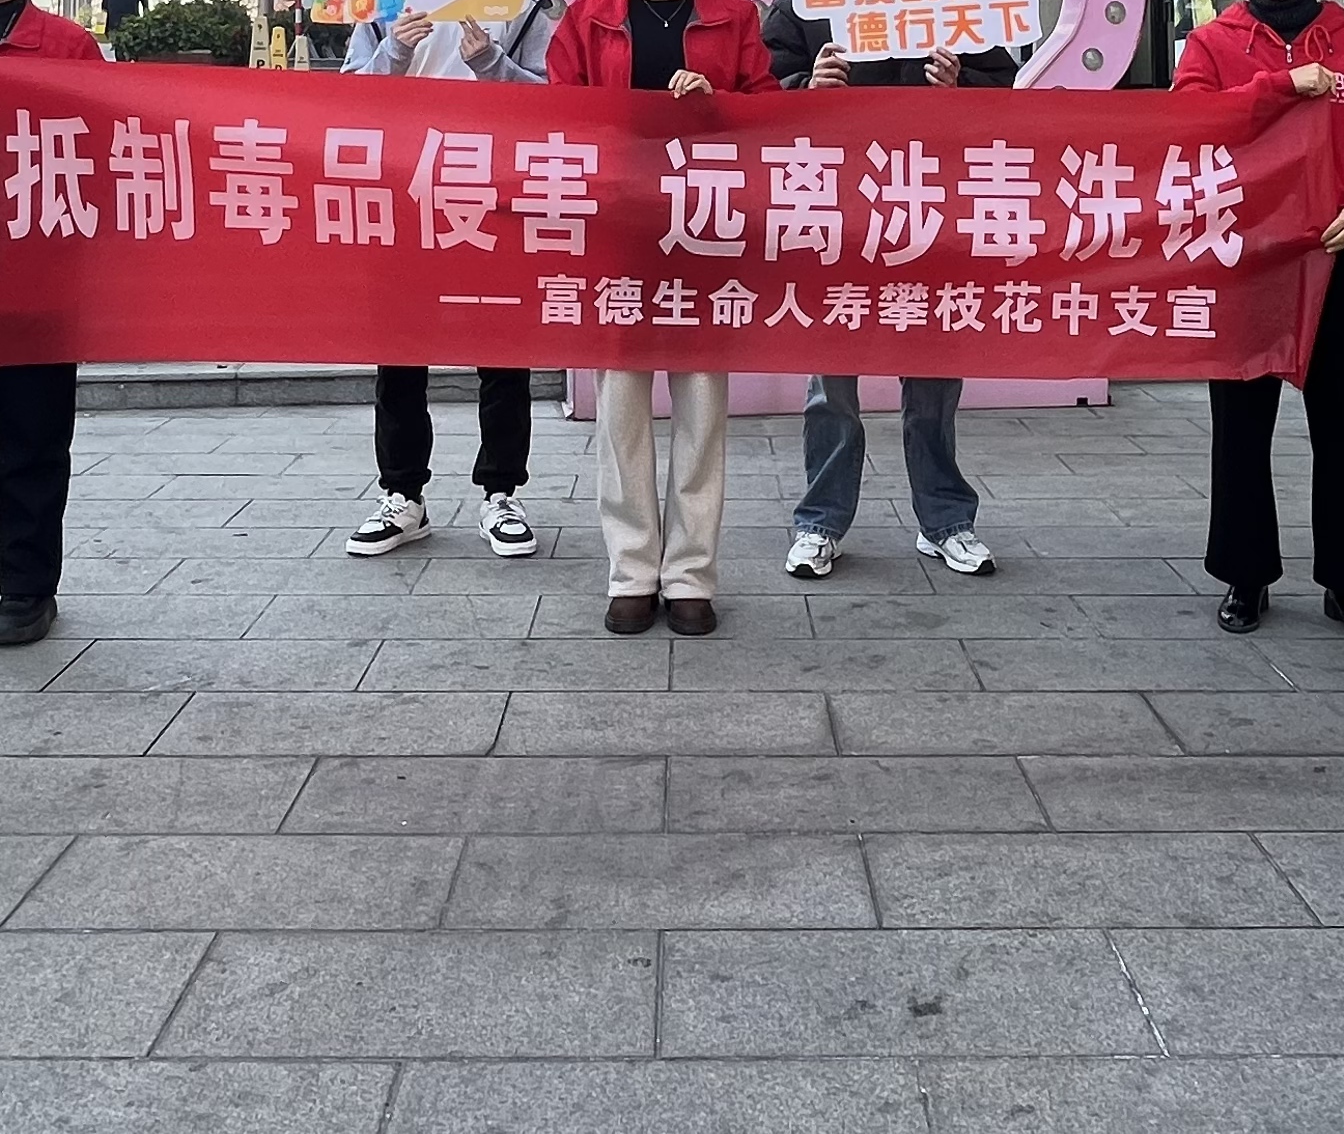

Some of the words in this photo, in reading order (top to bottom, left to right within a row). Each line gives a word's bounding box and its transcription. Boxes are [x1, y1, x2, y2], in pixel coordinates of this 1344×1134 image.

[846, 1, 1030, 54] 德行天下
[4, 108, 600, 257] 抵制毒品侵害
[658, 137, 1244, 267] 远离涉毒洗钱
